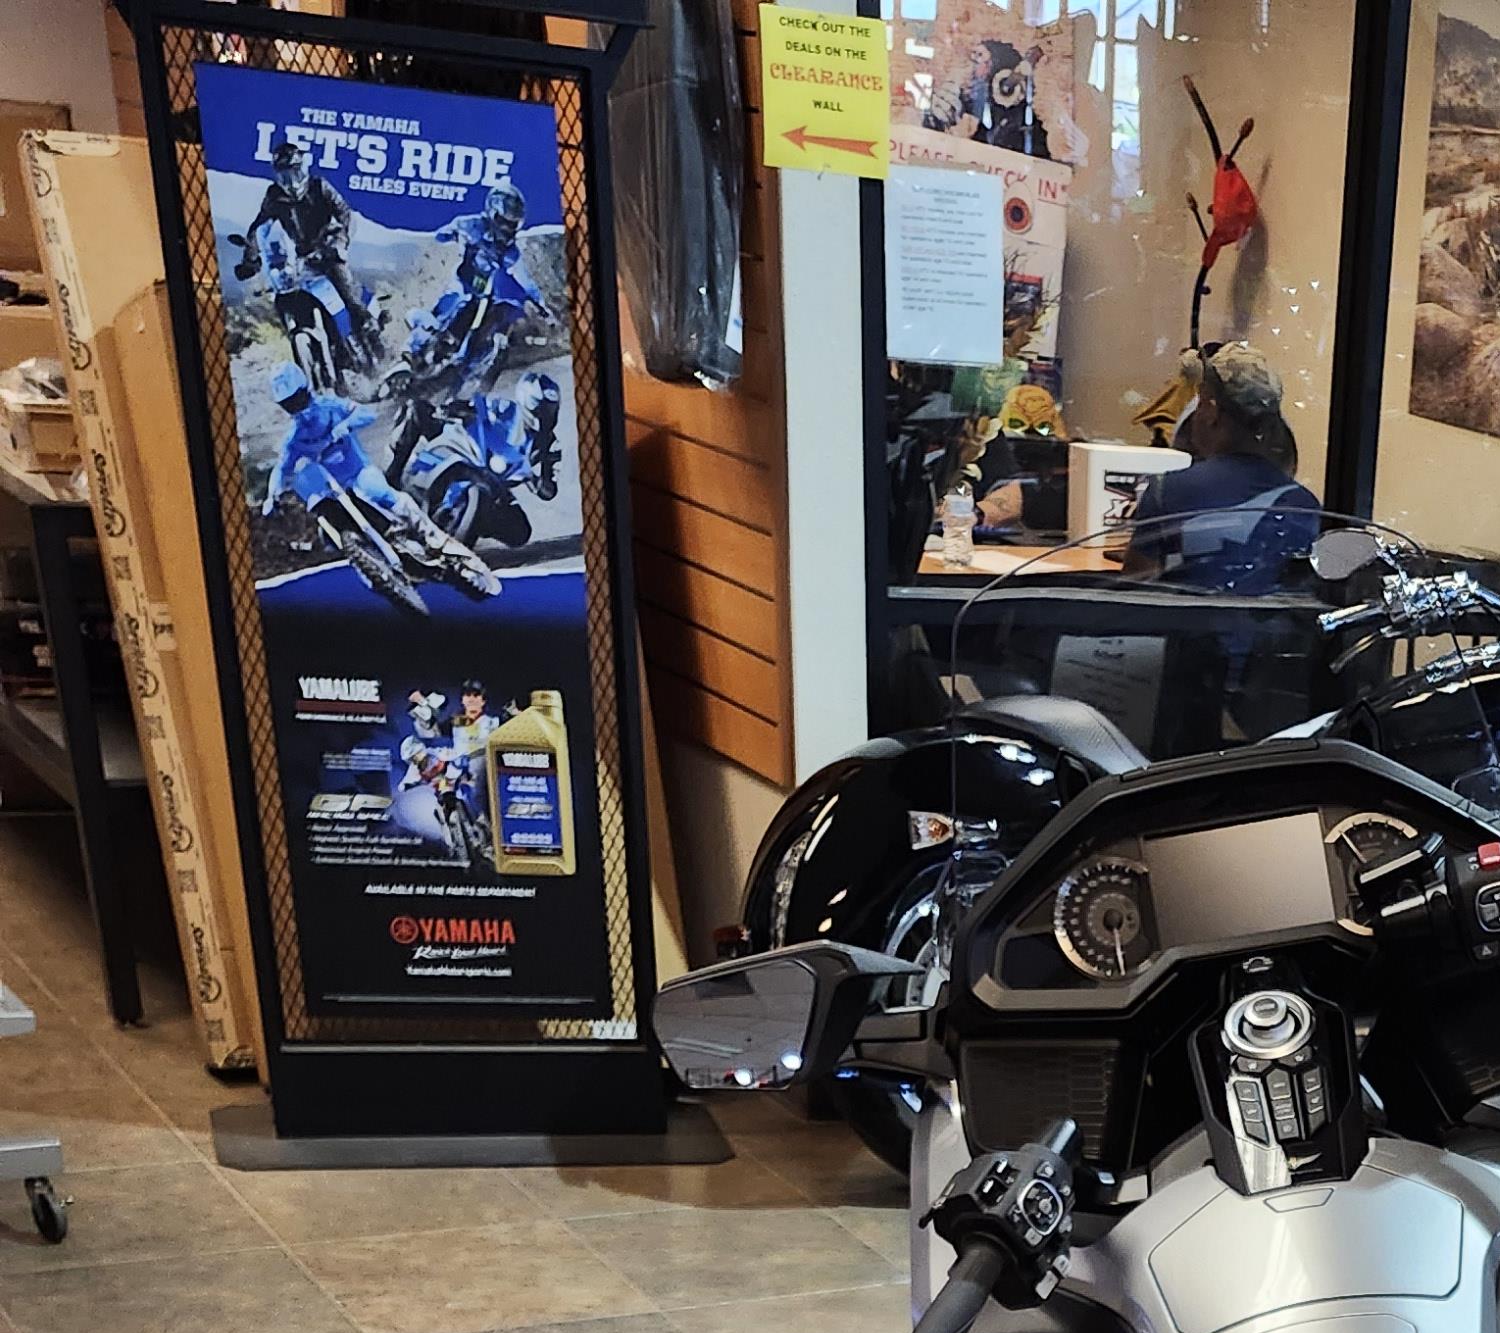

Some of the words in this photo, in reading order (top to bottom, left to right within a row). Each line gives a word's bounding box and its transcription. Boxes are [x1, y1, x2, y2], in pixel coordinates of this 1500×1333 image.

[779, 16, 818, 31] CHECK
[821, 22, 845, 34] OUT
[849, 26, 871, 38] THE
[785, 41, 821, 55] DEALS
[824, 46, 841, 57] ON
[844, 48, 867, 61] THE
[770, 62, 883, 91] CLEARANCE
[812, 100, 844, 113] WALL
[300, 107, 337, 126] THE
[341, 112, 420, 136] YAMAHA
[254, 121, 388, 174] LET'S
[398, 139, 514, 188] RIDE
[349, 174, 405, 196] SALES
[408, 180, 468, 202] EVENT
[418, 918, 516, 944] YAMAHA
